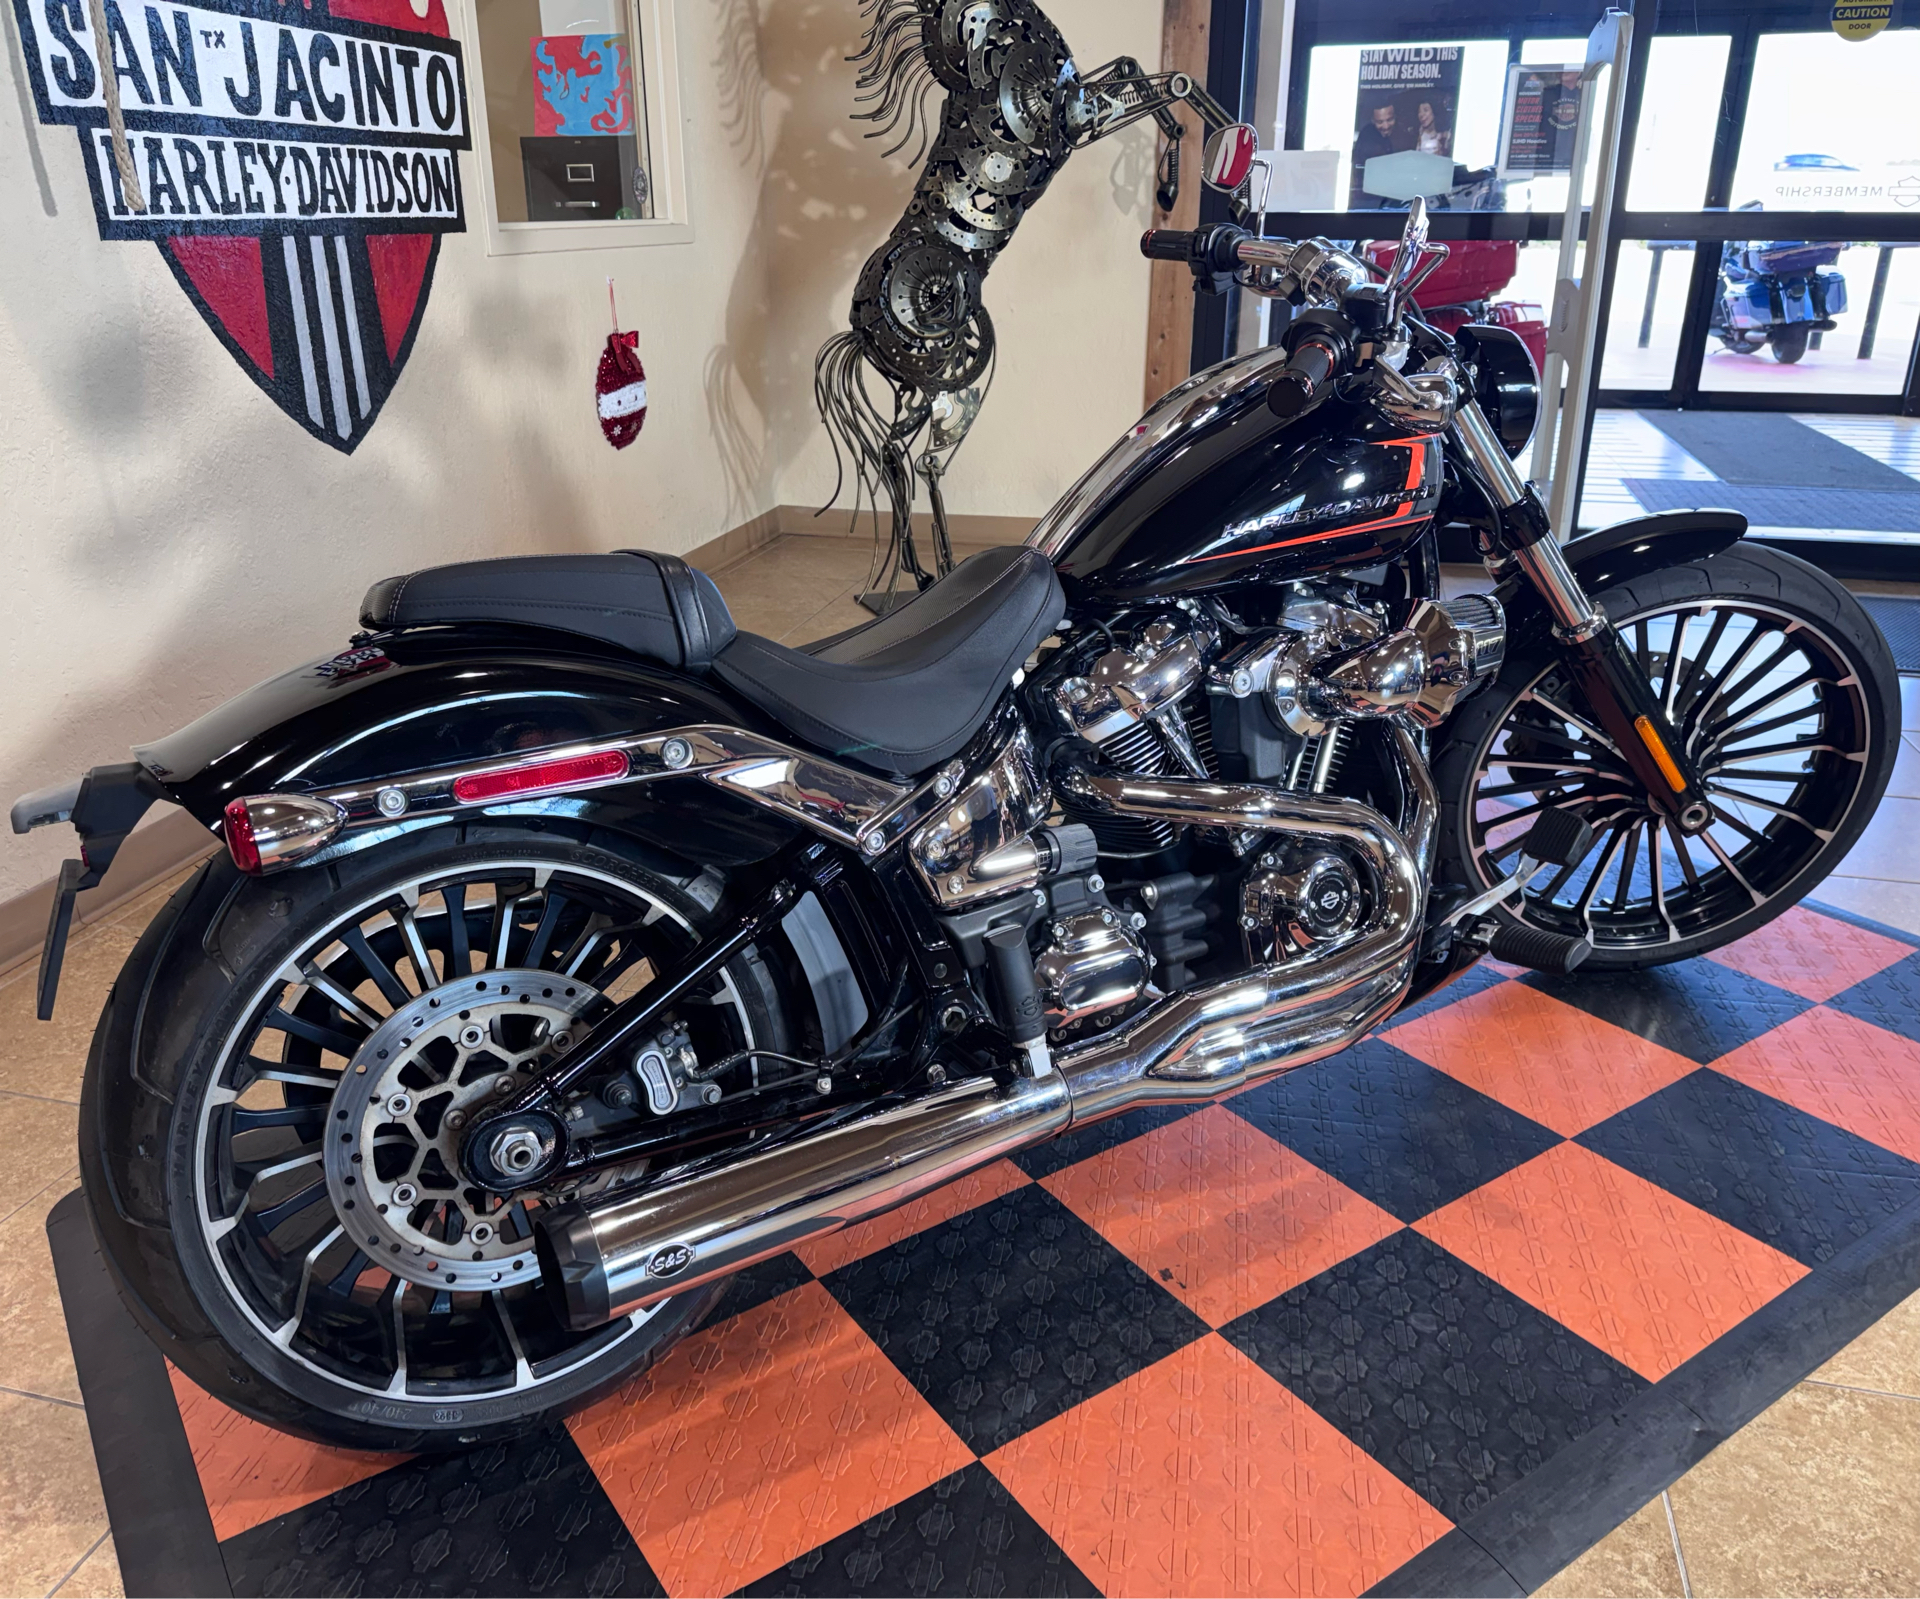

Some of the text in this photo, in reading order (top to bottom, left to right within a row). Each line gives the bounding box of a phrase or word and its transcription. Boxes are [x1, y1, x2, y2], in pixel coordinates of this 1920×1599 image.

[1836, 7, 1890, 19] CAUTION
[1362, 47, 1459, 63] STAY WILD THIS
[45, 0, 457, 131] SAN TX JACINTO
[1361, 63, 1441, 80] HOLIDAY SEASON.
[1518, 97, 1540, 105] MOTOR
[653, 1248, 687, 1273] S&S
